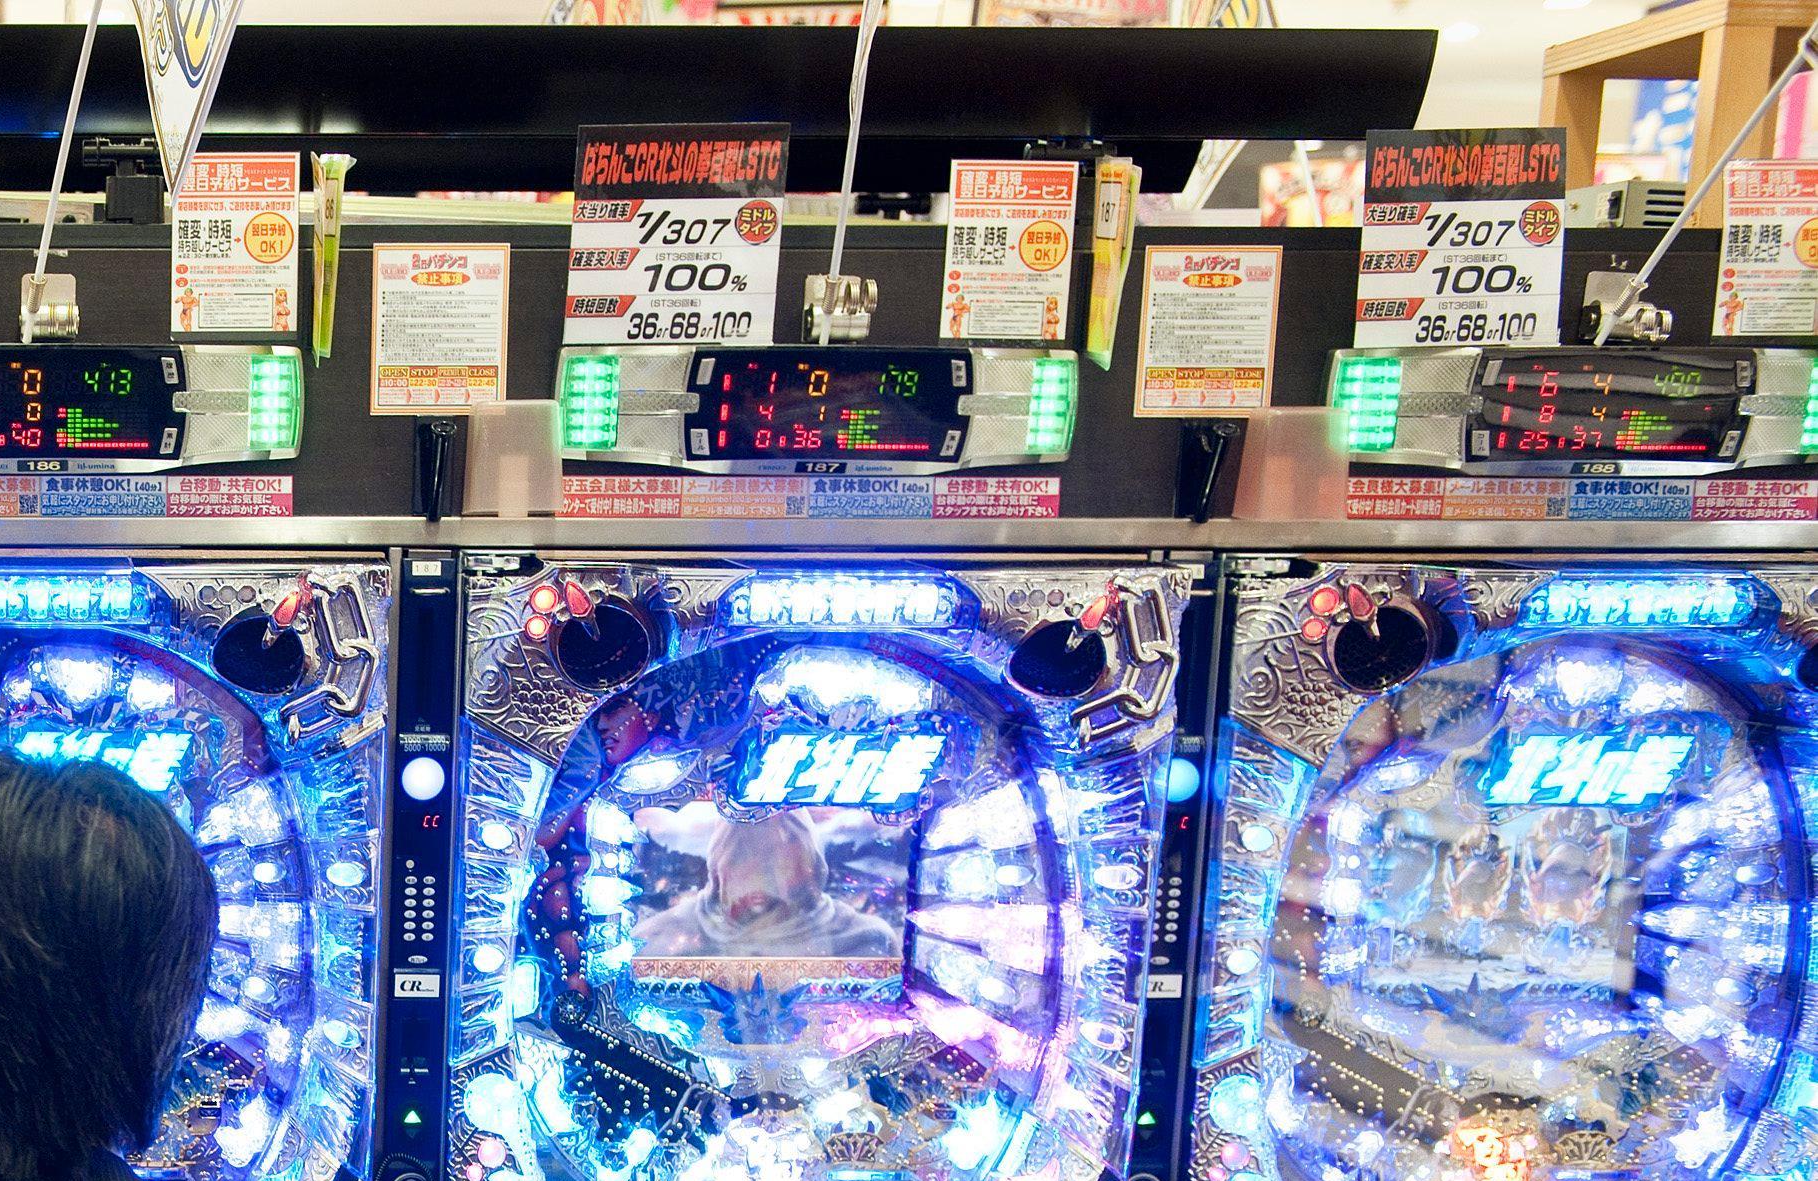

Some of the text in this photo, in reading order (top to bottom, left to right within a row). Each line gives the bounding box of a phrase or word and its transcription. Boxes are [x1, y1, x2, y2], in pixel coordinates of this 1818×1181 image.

[183, 177, 291, 191] 翌日予約サービス
[960, 185, 1068, 199] 翌日予約サービス
[576, 203, 630, 219] 大当り確率
[741, 208, 775, 221] ミドル
[1101, 203, 1116, 223] 187
[1366, 205, 1419, 222] 大当り確率
[1525, 210, 1557, 223] ミドル
[252, 224, 286, 236] 翌日予約
[1027, 232, 1061, 244] 翌日予約
[261, 241, 283, 253] OK!
[572, 251, 628, 267] 確変突入率
[1034, 250, 1057, 262] OK!
[1362, 253, 1417, 270] 確変突入率
[644, 264, 747, 293] 100%
[1432, 265, 1533, 295] 100%
[572, 299, 619, 314] 時短回数
[1362, 301, 1408, 317] 時短回数
[411, 369, 437, 377] STOP
[469, 369, 496, 377] CLOSE
[1236, 370, 1262, 378] CLOSE
[85, 369, 132, 394] 413
[1540, 372, 1559, 397] 6
[27, 460, 61, 471] 186
[805, 463, 840, 472] 187
[1582, 465, 1615, 473] 188
[415, 564, 439, 573] 187
[1486, 735, 1695, 806] 北斗の拳
[399, 980, 422, 992] CR
